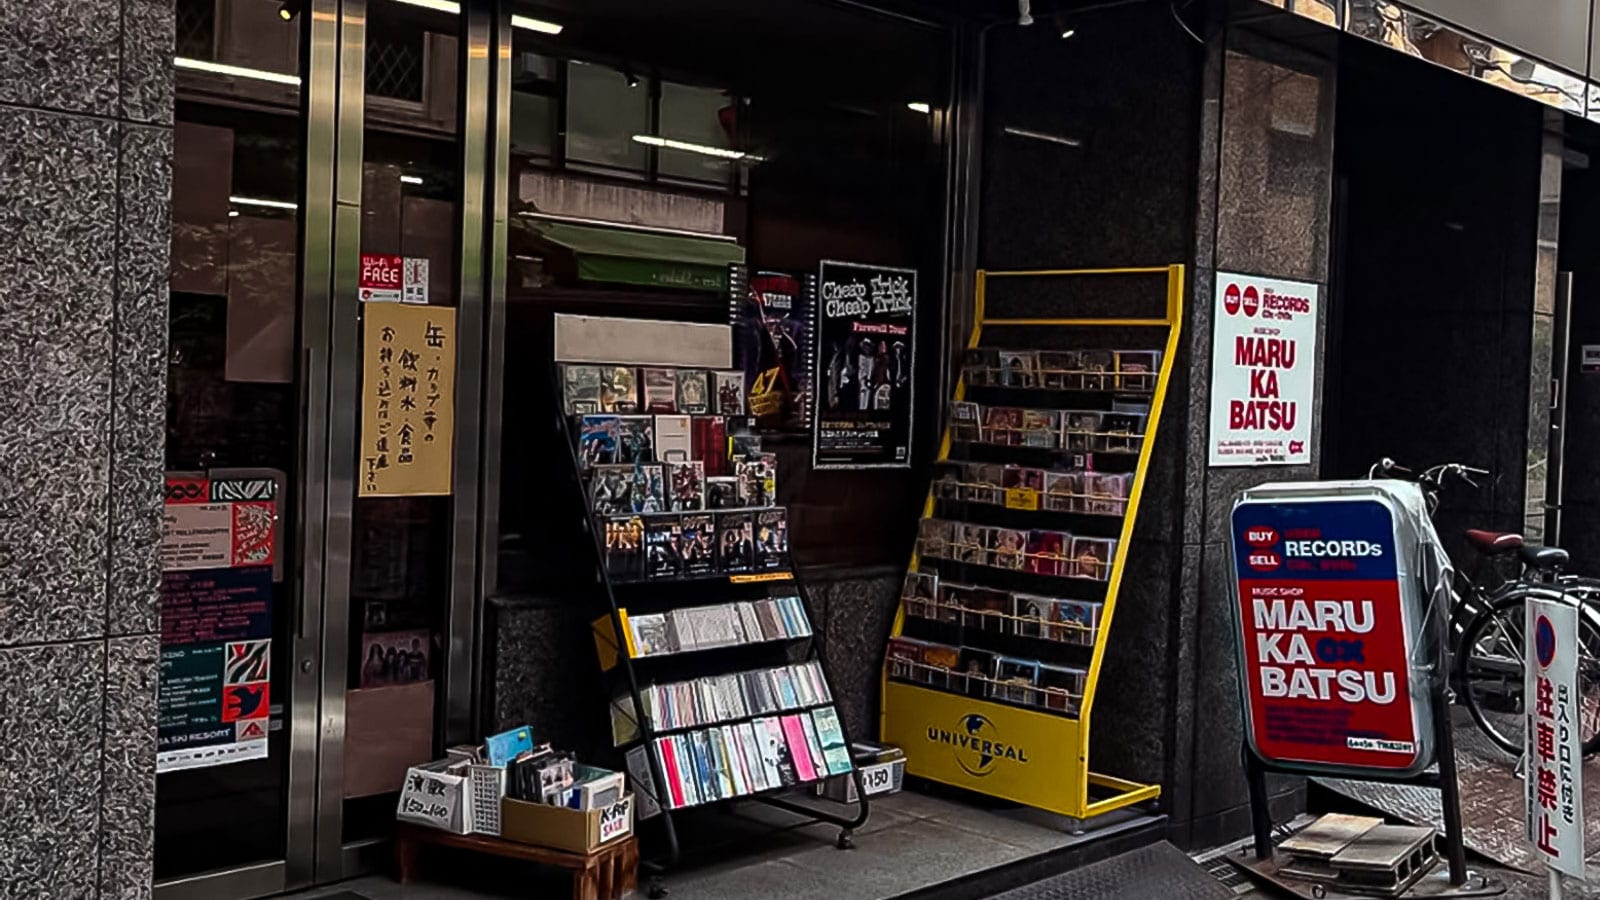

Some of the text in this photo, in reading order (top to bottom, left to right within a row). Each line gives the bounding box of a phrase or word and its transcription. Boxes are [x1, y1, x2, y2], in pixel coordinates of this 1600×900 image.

[363, 267, 399, 283] FREE
[822, 274, 909, 299] Cheap Trick
[826, 297, 912, 318] Cheap Trick
[1235, 336, 1296, 369] MARU
[1250, 369, 1279, 399] KA
[1229, 400, 1296, 431] BATSU
[1248, 531, 1274, 541] BUY
[1285, 541, 1383, 557] RECORDs
[1249, 555, 1278, 566] SELL
[1252, 588, 1304, 596] MUSIC SHOP
[1252, 599, 1375, 633] MARU
[1256, 633, 1316, 665] KA
[1260, 666, 1396, 704] BATSU
[189, 728, 231, 740] RESORT
[927, 727, 1028, 763] UNIVERSAL
[1536, 675, 1560, 858] 駐車禁止
